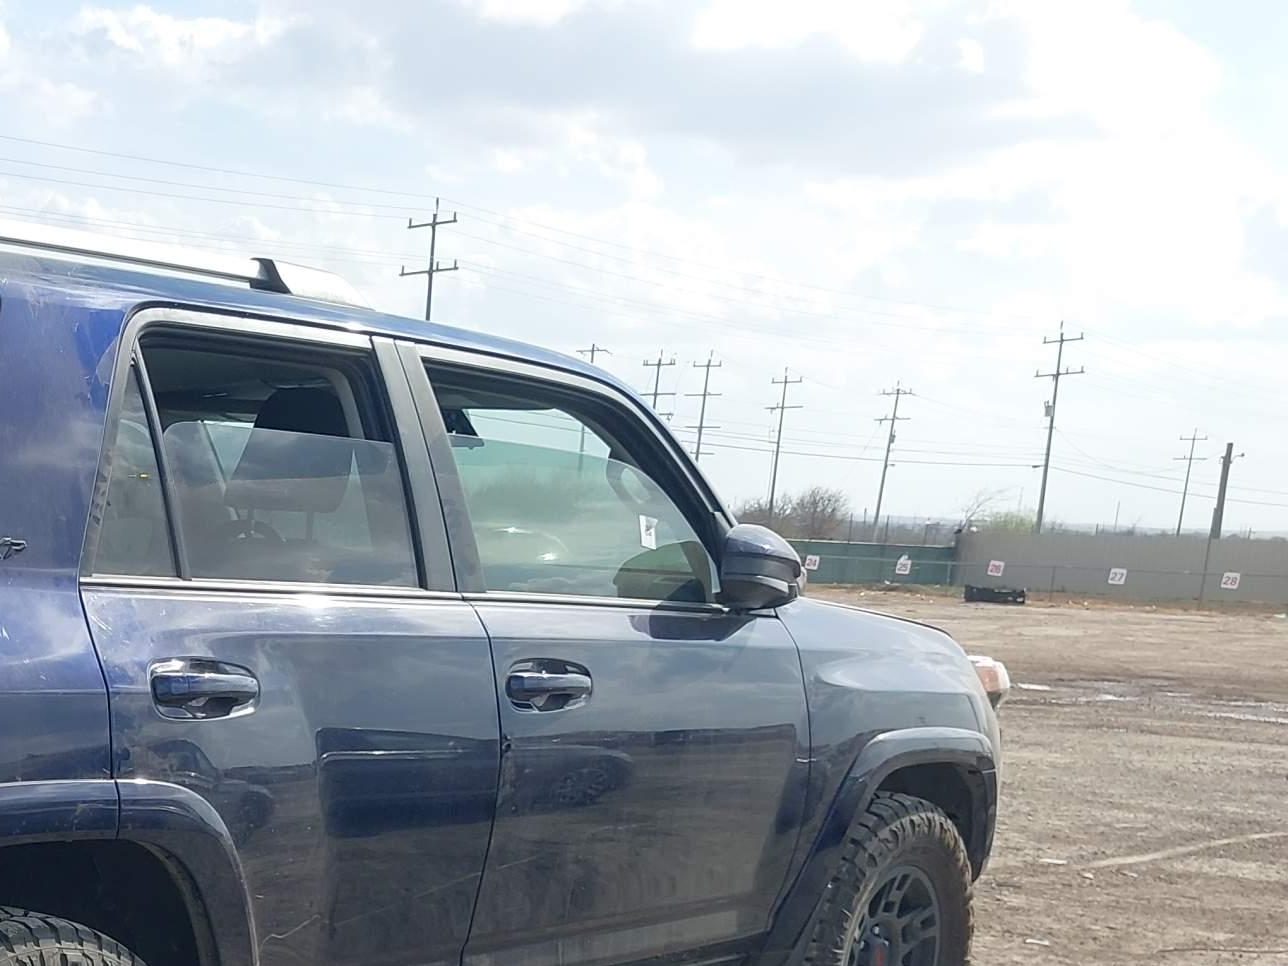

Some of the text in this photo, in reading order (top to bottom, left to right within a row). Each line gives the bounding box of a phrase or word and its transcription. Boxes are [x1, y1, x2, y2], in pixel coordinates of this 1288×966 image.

[988, 563, 1003, 575] 26
[1110, 571, 1125, 583] 27
[1222, 575, 1238, 587] 28
